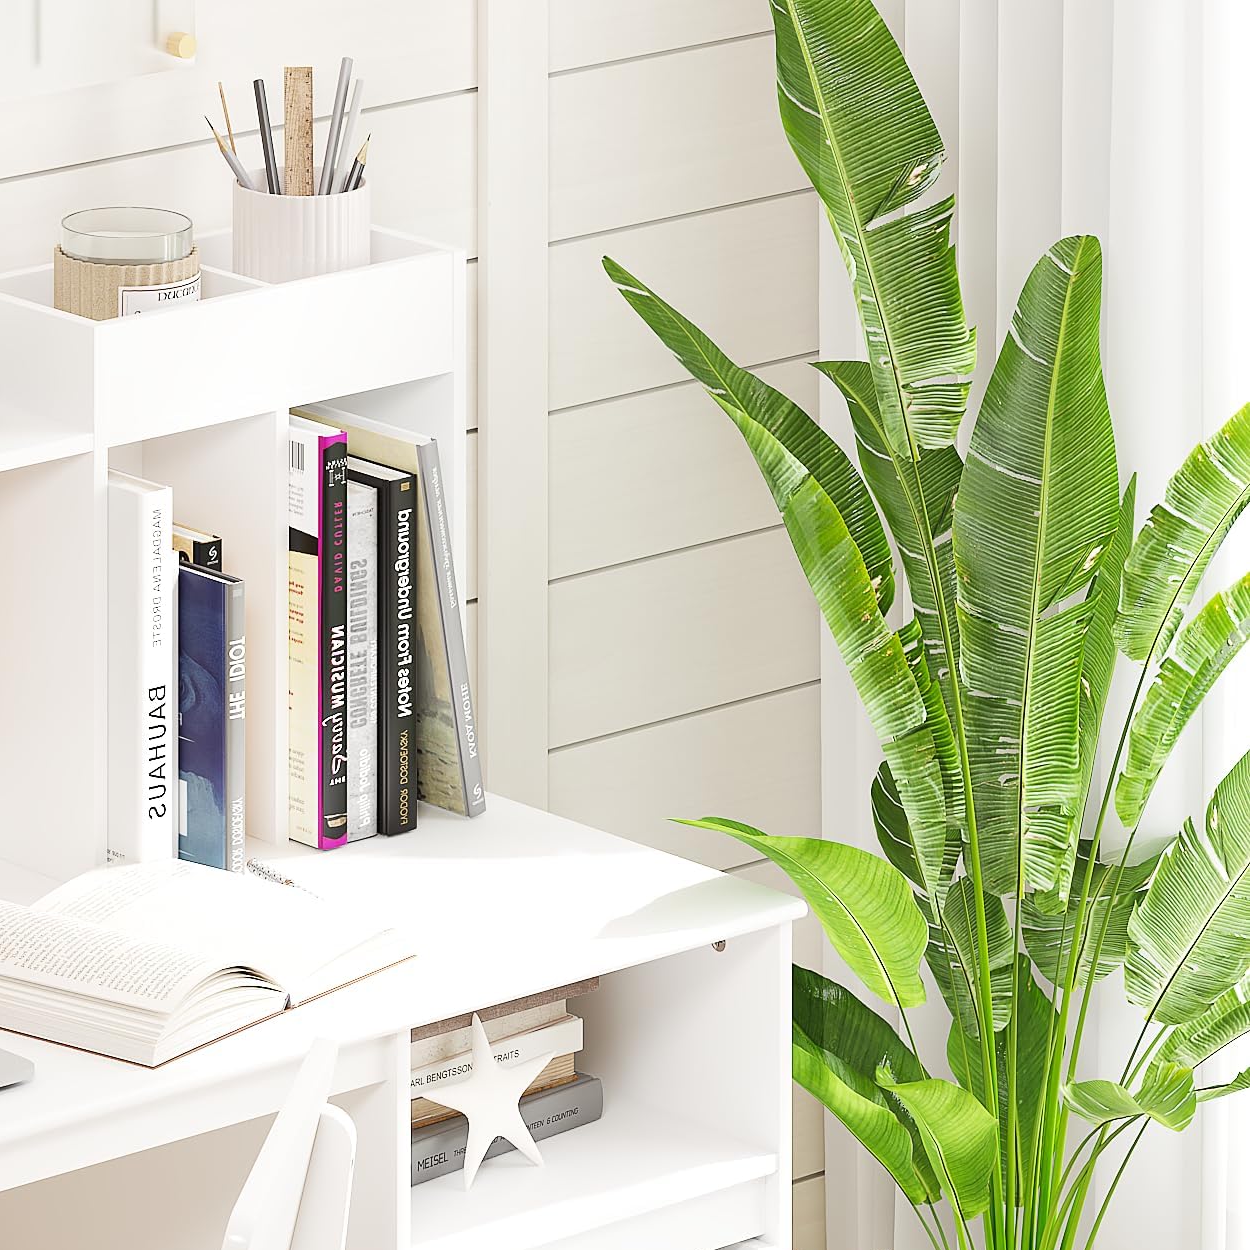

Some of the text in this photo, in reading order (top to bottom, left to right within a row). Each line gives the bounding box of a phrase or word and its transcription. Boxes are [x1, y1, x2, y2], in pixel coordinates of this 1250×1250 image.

[410, 1079, 425, 1088] ARL
[426, 1063, 474, 1085] BENGTSSON
[417, 1152, 449, 1172] MEISEL
[551, 1106, 579, 1123] COUNTING
